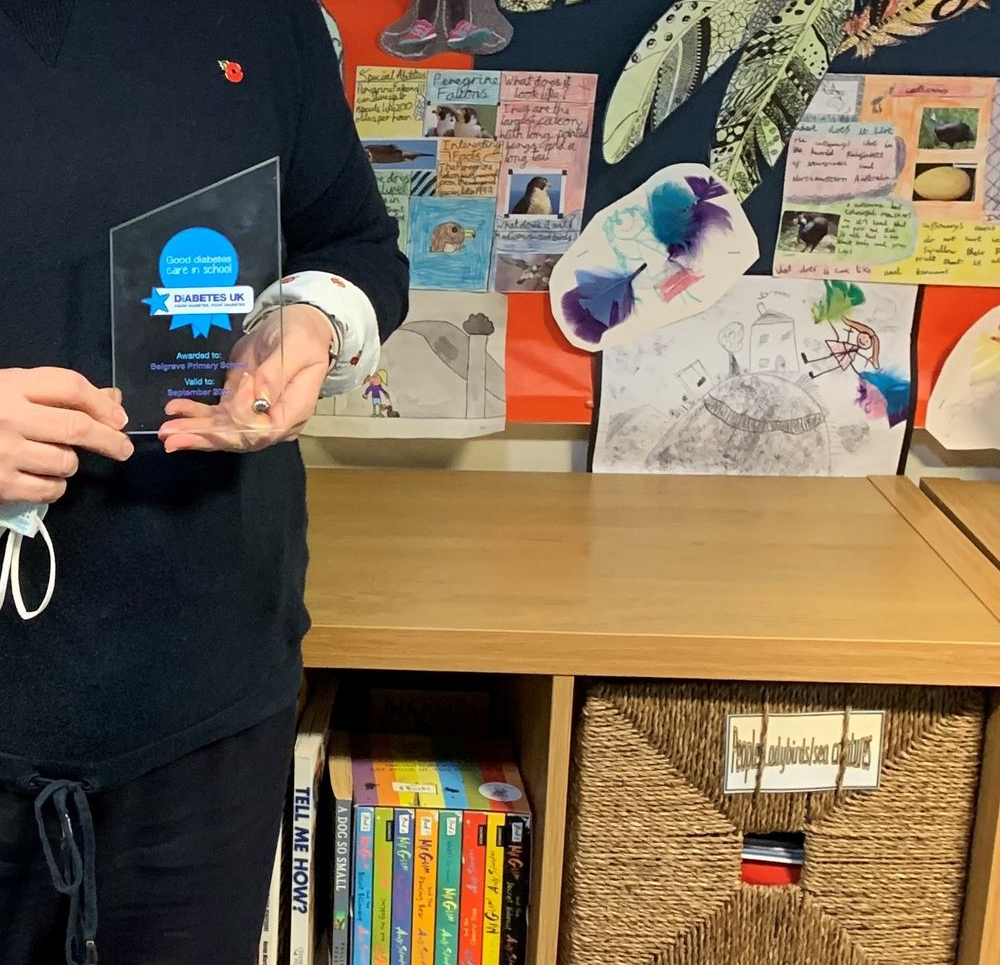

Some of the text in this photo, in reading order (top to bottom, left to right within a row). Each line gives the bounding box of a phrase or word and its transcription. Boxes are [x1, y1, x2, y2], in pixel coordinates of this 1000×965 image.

[166, 255, 232, 265] Good diabetes
[166, 263, 232, 275] care in school
[230, 292, 245, 302] UK
[176, 351, 222, 360] Awarded to:
[150, 362, 186, 372] Belgrave
[187, 362, 218, 371] Primary
[184, 377, 215, 386] Valid to:
[167, 388, 211, 397] September
[292, 787, 311, 914] TELL ME HOW?
[336, 805, 348, 891] A DOG SO SMALL
[419, 853, 433, 873] Gum
